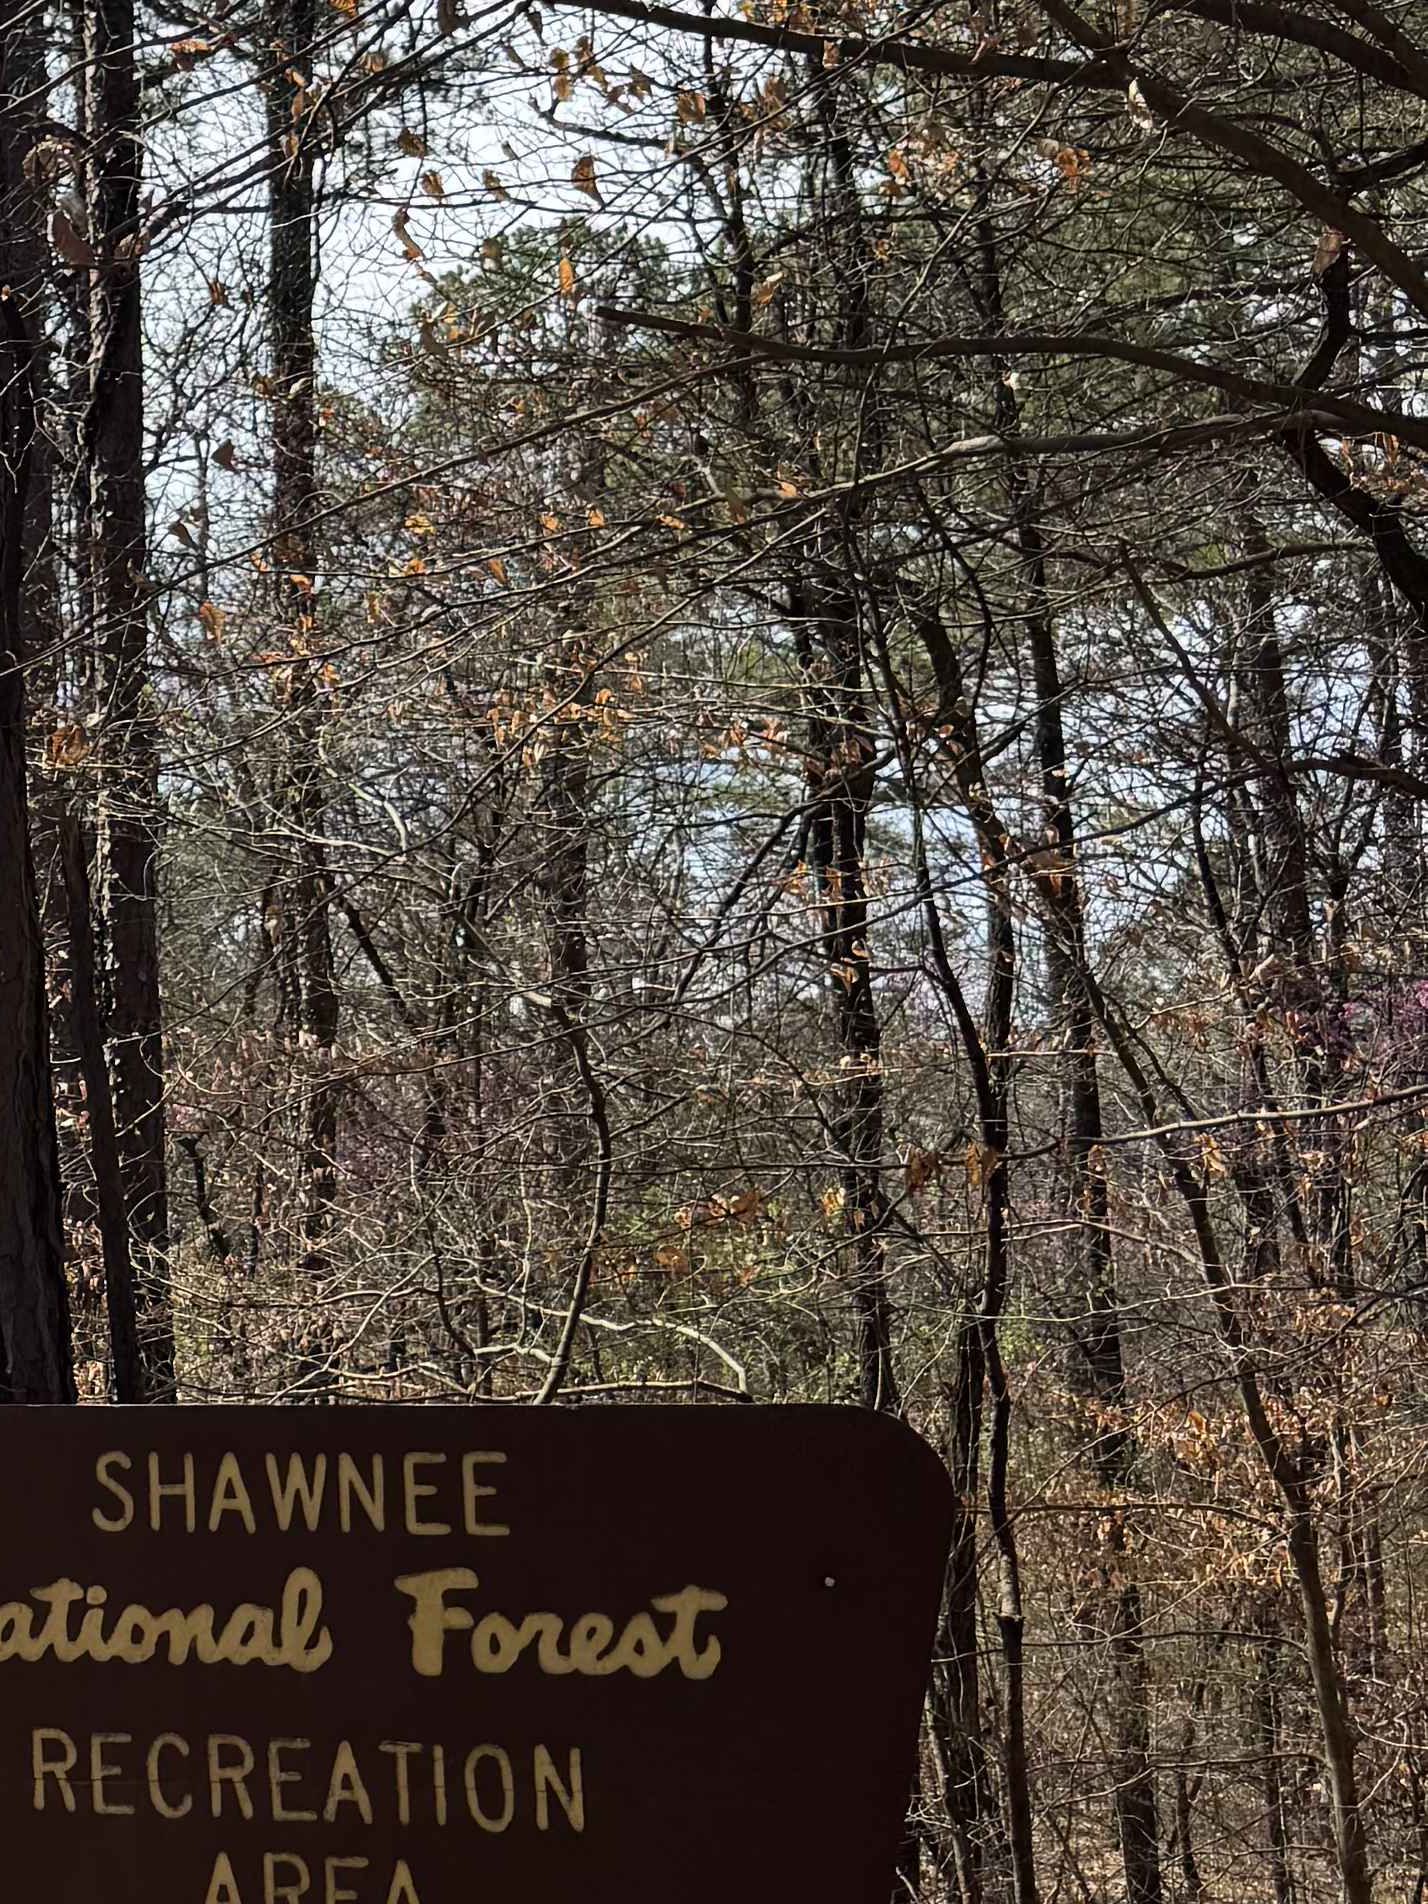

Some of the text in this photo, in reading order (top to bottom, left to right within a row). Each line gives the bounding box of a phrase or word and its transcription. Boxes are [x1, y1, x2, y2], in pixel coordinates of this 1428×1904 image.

[91, 1450, 511, 1538] SHAWNEE
[395, 1567, 729, 1682] Forest
[31, 1728, 585, 1834] RECREATION
